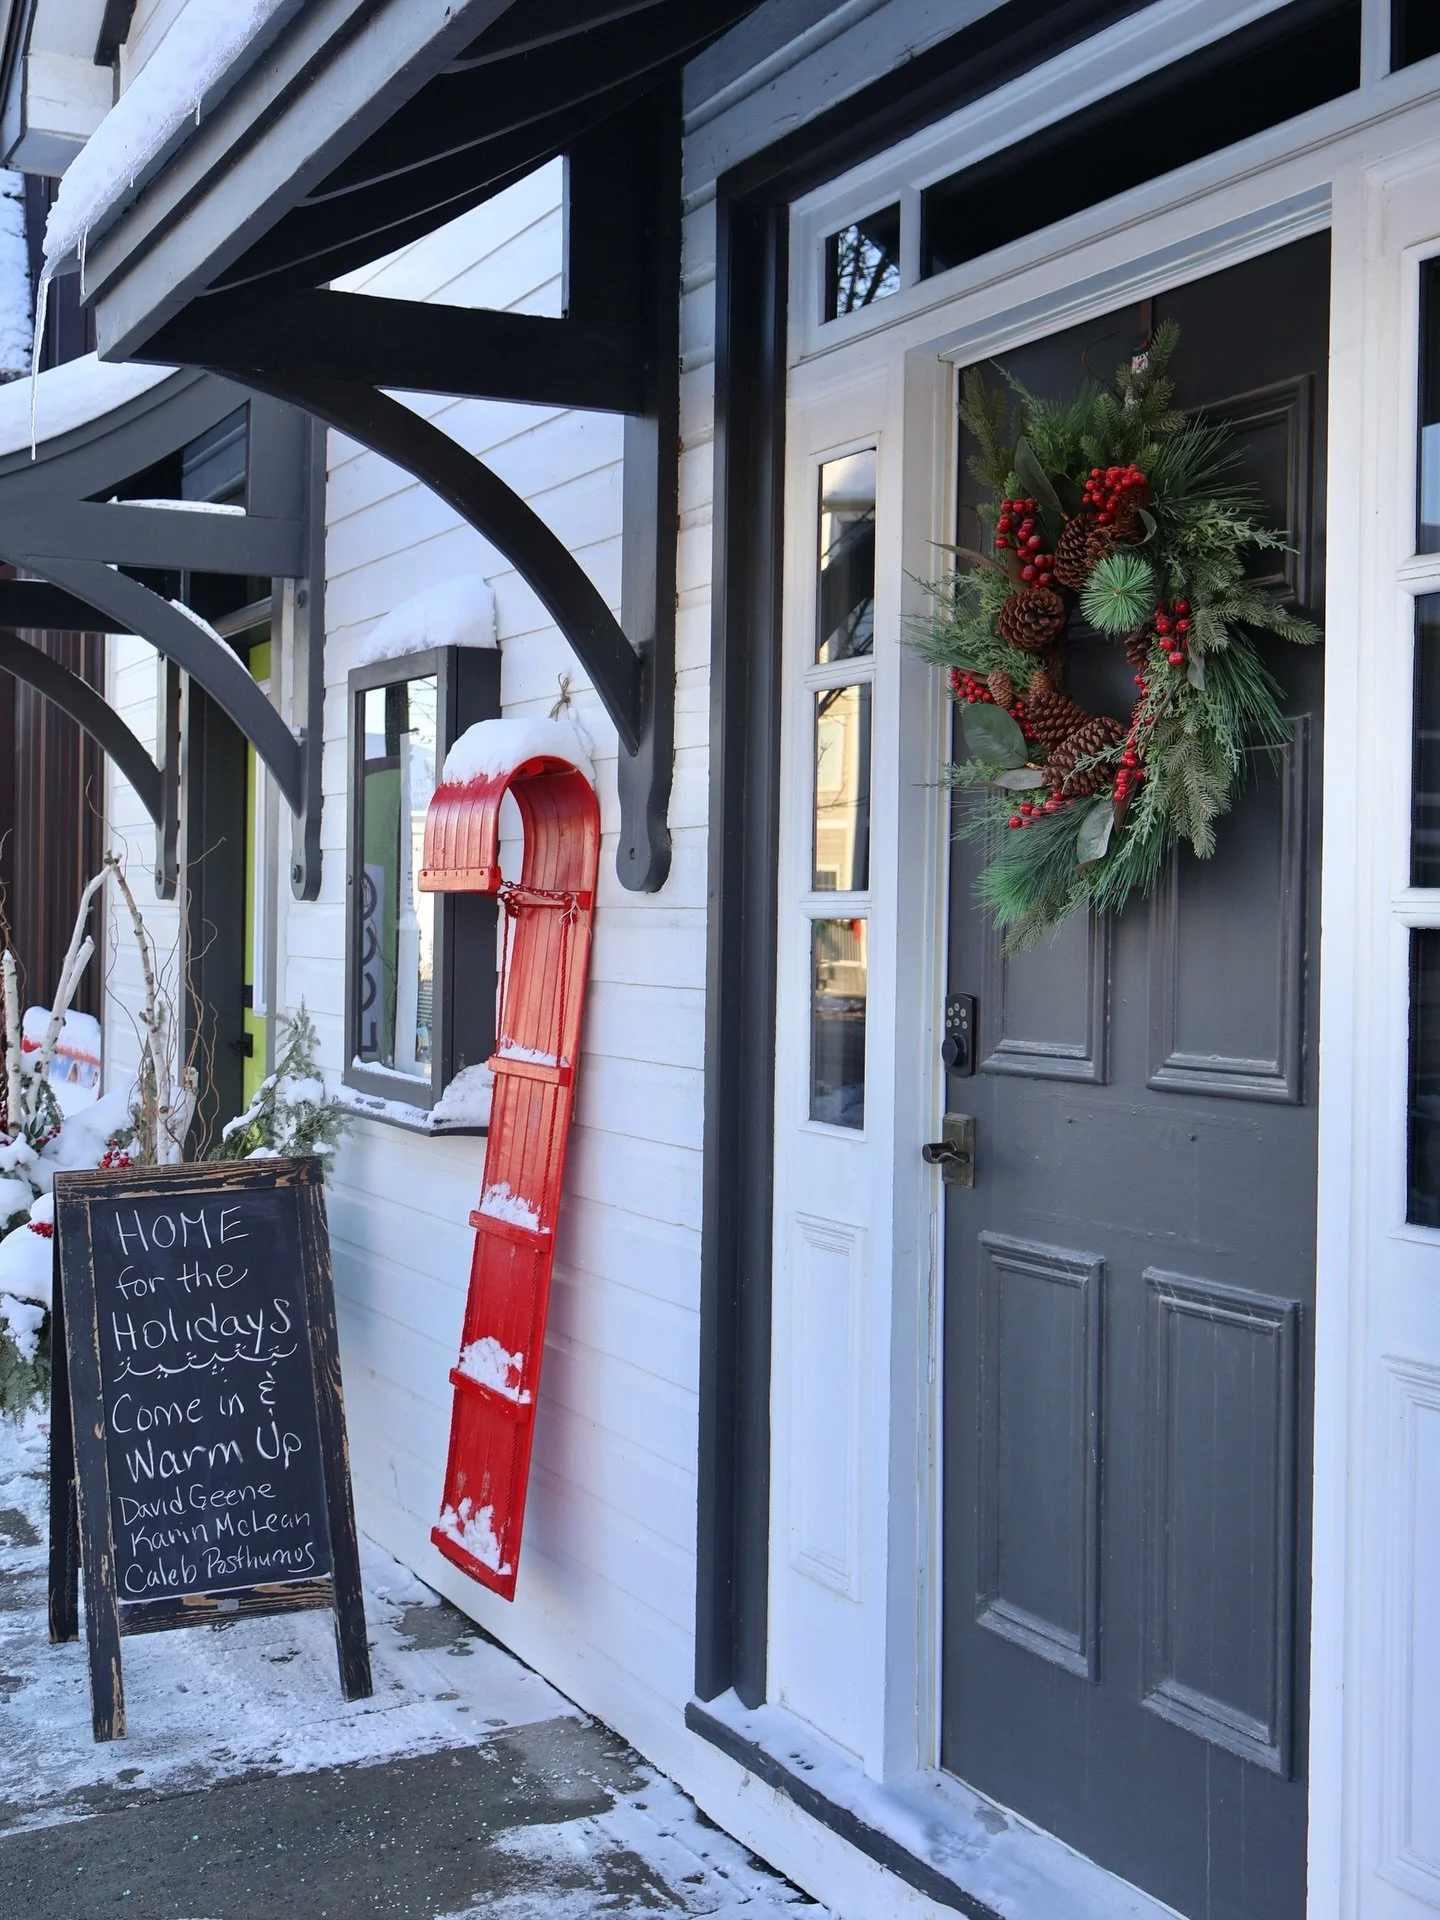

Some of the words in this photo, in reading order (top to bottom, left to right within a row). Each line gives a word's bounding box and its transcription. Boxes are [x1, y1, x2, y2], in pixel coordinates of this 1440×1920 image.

[115, 1205, 249, 1256] HOME
[115, 1265, 165, 1299] for
[176, 1260, 248, 1293] the
[112, 1393, 203, 1433] Come
[219, 1392, 245, 1416] in
[125, 1439, 244, 1484] Warm
[255, 1420, 303, 1470] Up
[118, 1486, 188, 1526] David
[189, 1483, 276, 1510] Geene
[131, 1523, 210, 1557] Karin
[216, 1511, 310, 1539] McLean
[124, 1555, 197, 1593] Caleb
